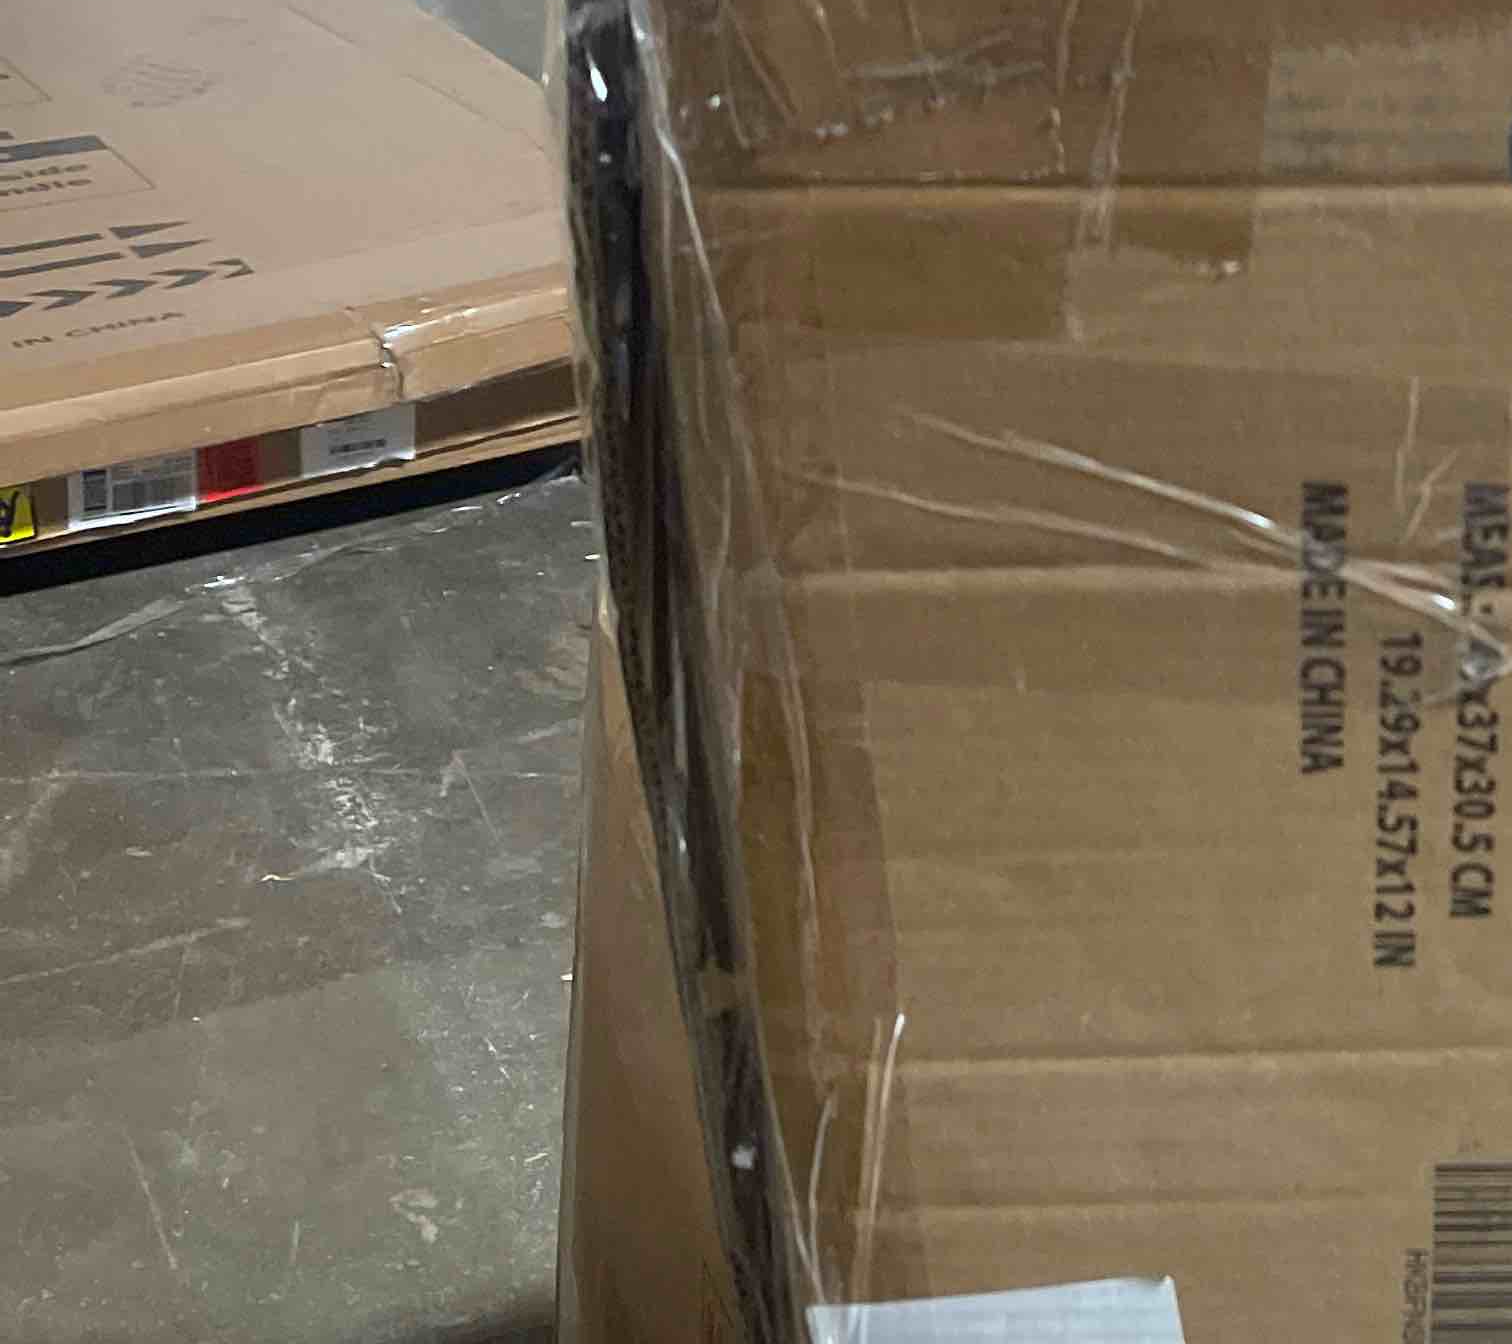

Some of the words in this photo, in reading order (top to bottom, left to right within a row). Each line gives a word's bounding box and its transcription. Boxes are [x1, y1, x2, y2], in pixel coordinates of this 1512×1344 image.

[11, 335, 54, 349] IN
[65, 311, 187, 338] CHINA
[1301, 482, 1349, 601] MADE
[1300, 609, 1346, 647] IN
[1300, 656, 1347, 775] CHINA
[1451, 636, 1506, 855] x37x30.5
[1449, 863, 1495, 920] CM
[1373, 929, 1416, 969] IN
